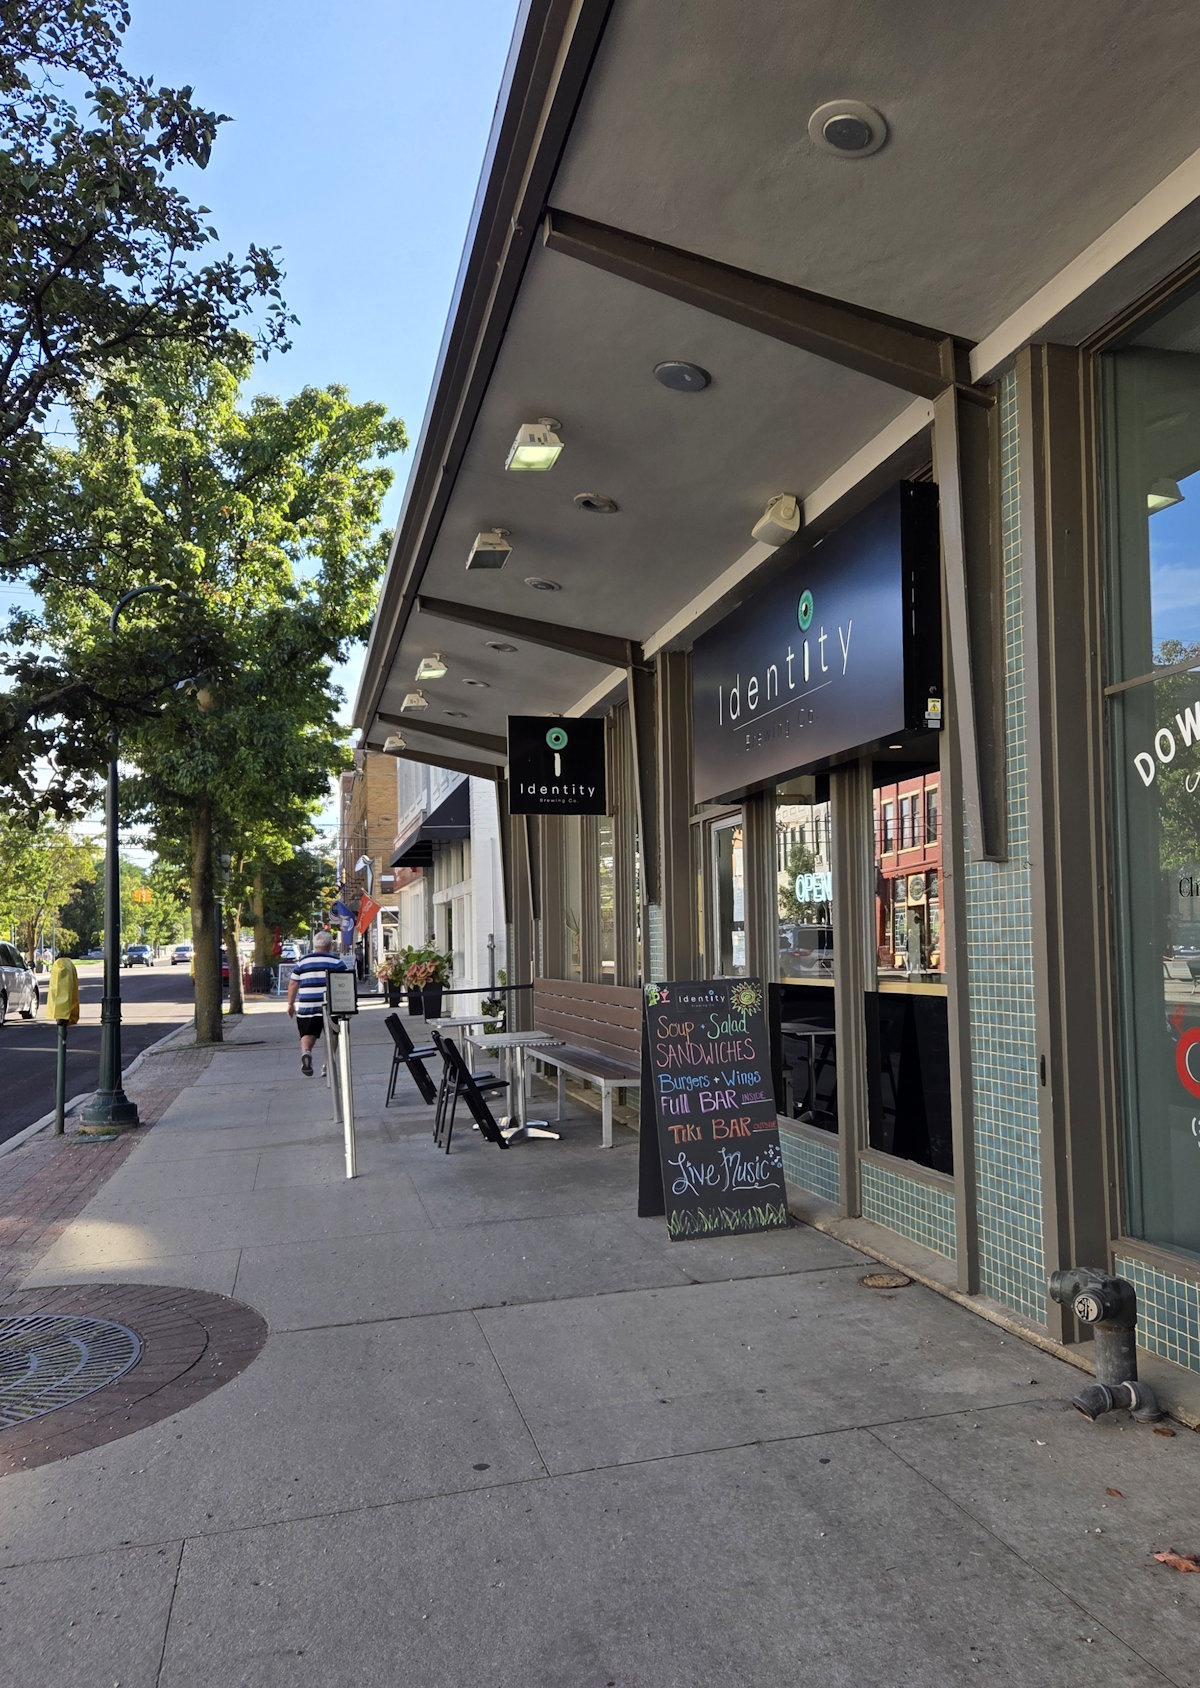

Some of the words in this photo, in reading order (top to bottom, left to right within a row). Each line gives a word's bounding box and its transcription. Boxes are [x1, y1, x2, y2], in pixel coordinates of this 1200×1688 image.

[719, 589, 852, 726] Identity
[520, 783, 595, 798] Identity
[795, 872, 833, 903] OPEN
[678, 990, 725, 1003] Identity
[656, 1015, 695, 1045] Soup
[707, 1009, 750, 1039] Salad
[656, 1038, 756, 1068] SANDWICHES
[657, 1073, 711, 1094] Burgers
[721, 1069, 762, 1087] Wings
[699, 1089, 739, 1114] BAR
[711, 1117, 752, 1140] BAR
[668, 1151, 720, 1196] Live
[717, 1146, 770, 1192] Music
